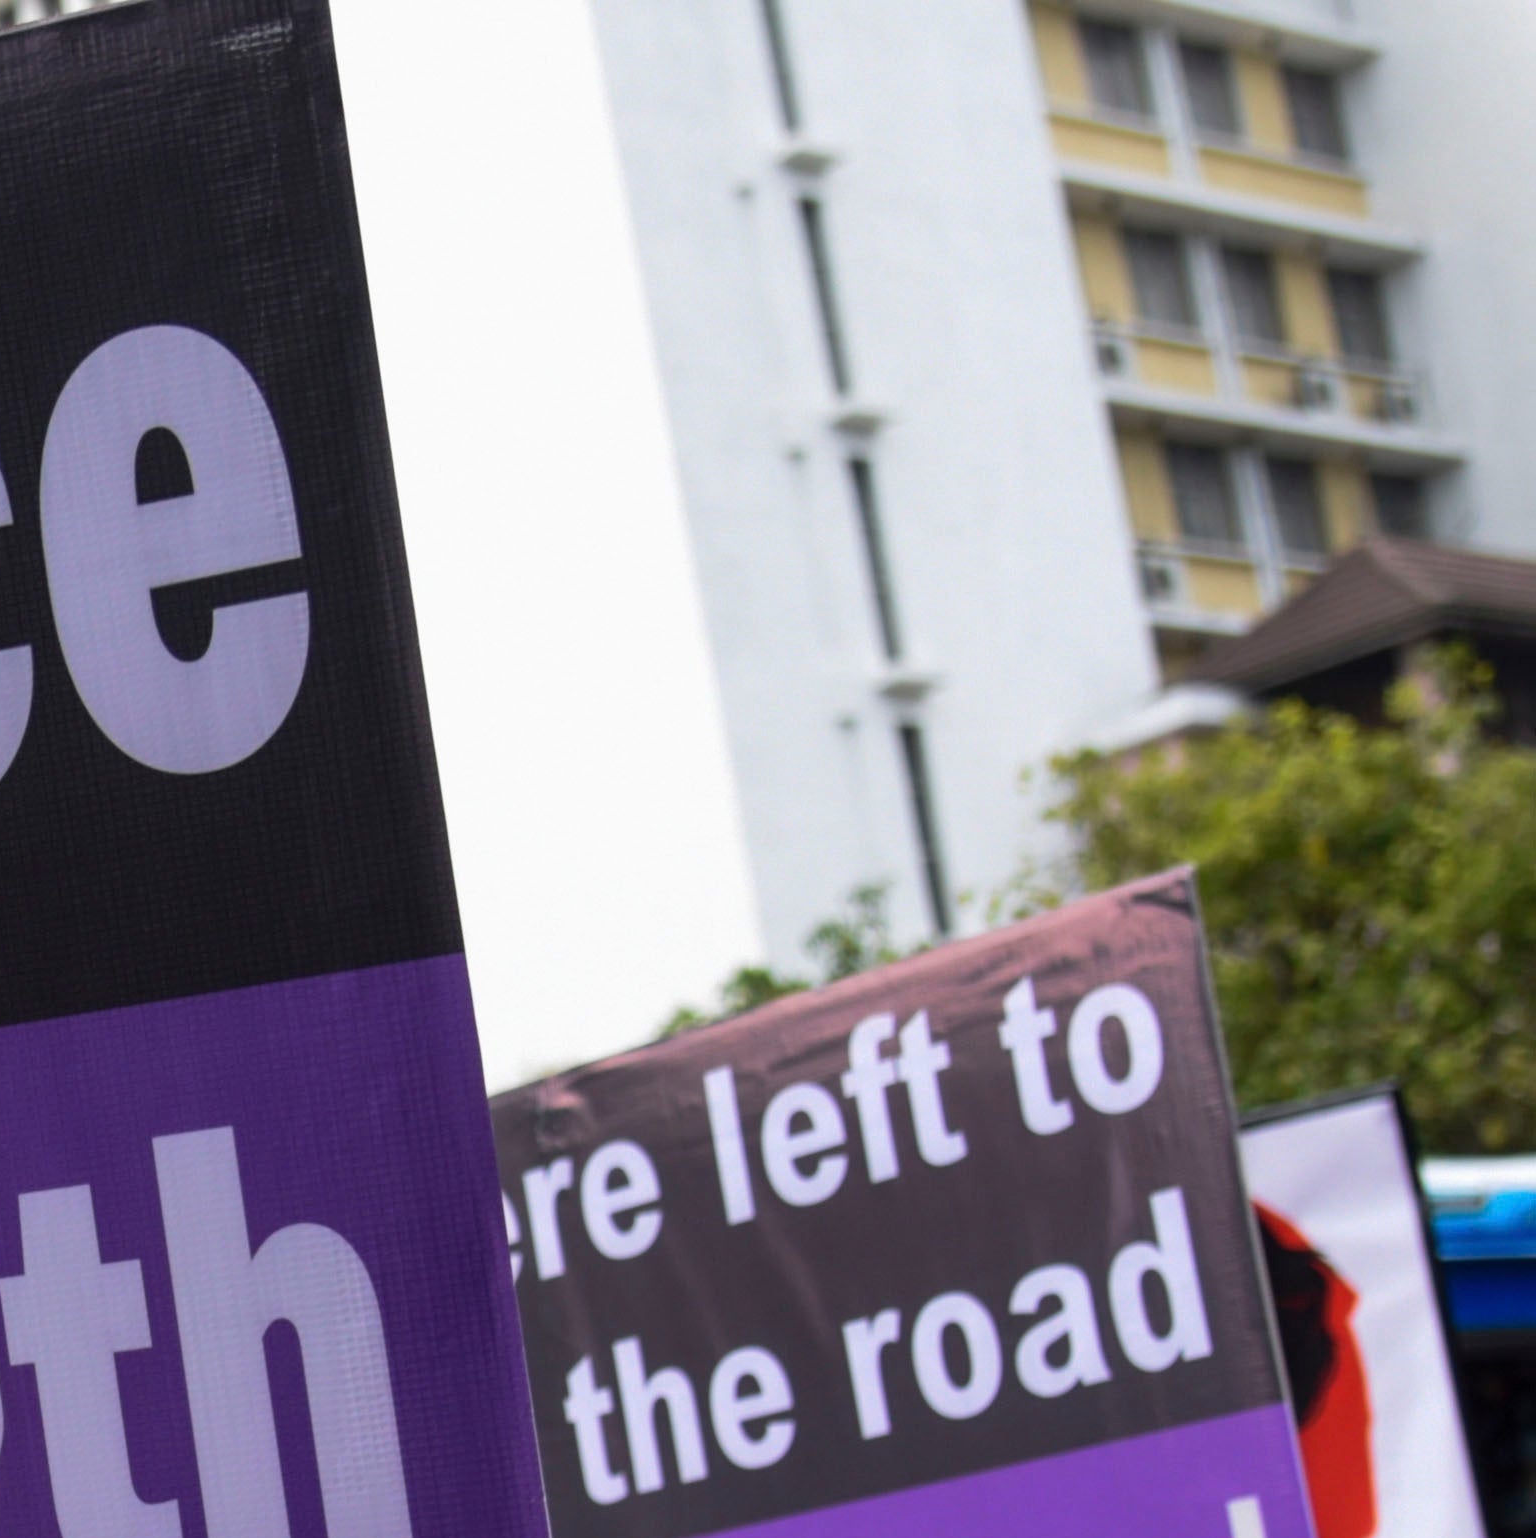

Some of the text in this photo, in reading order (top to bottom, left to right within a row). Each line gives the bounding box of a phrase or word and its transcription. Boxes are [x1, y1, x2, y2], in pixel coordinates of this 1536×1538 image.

[501, 974, 1165, 1285] re left to
[563, 1186, 1213, 1505] the road
